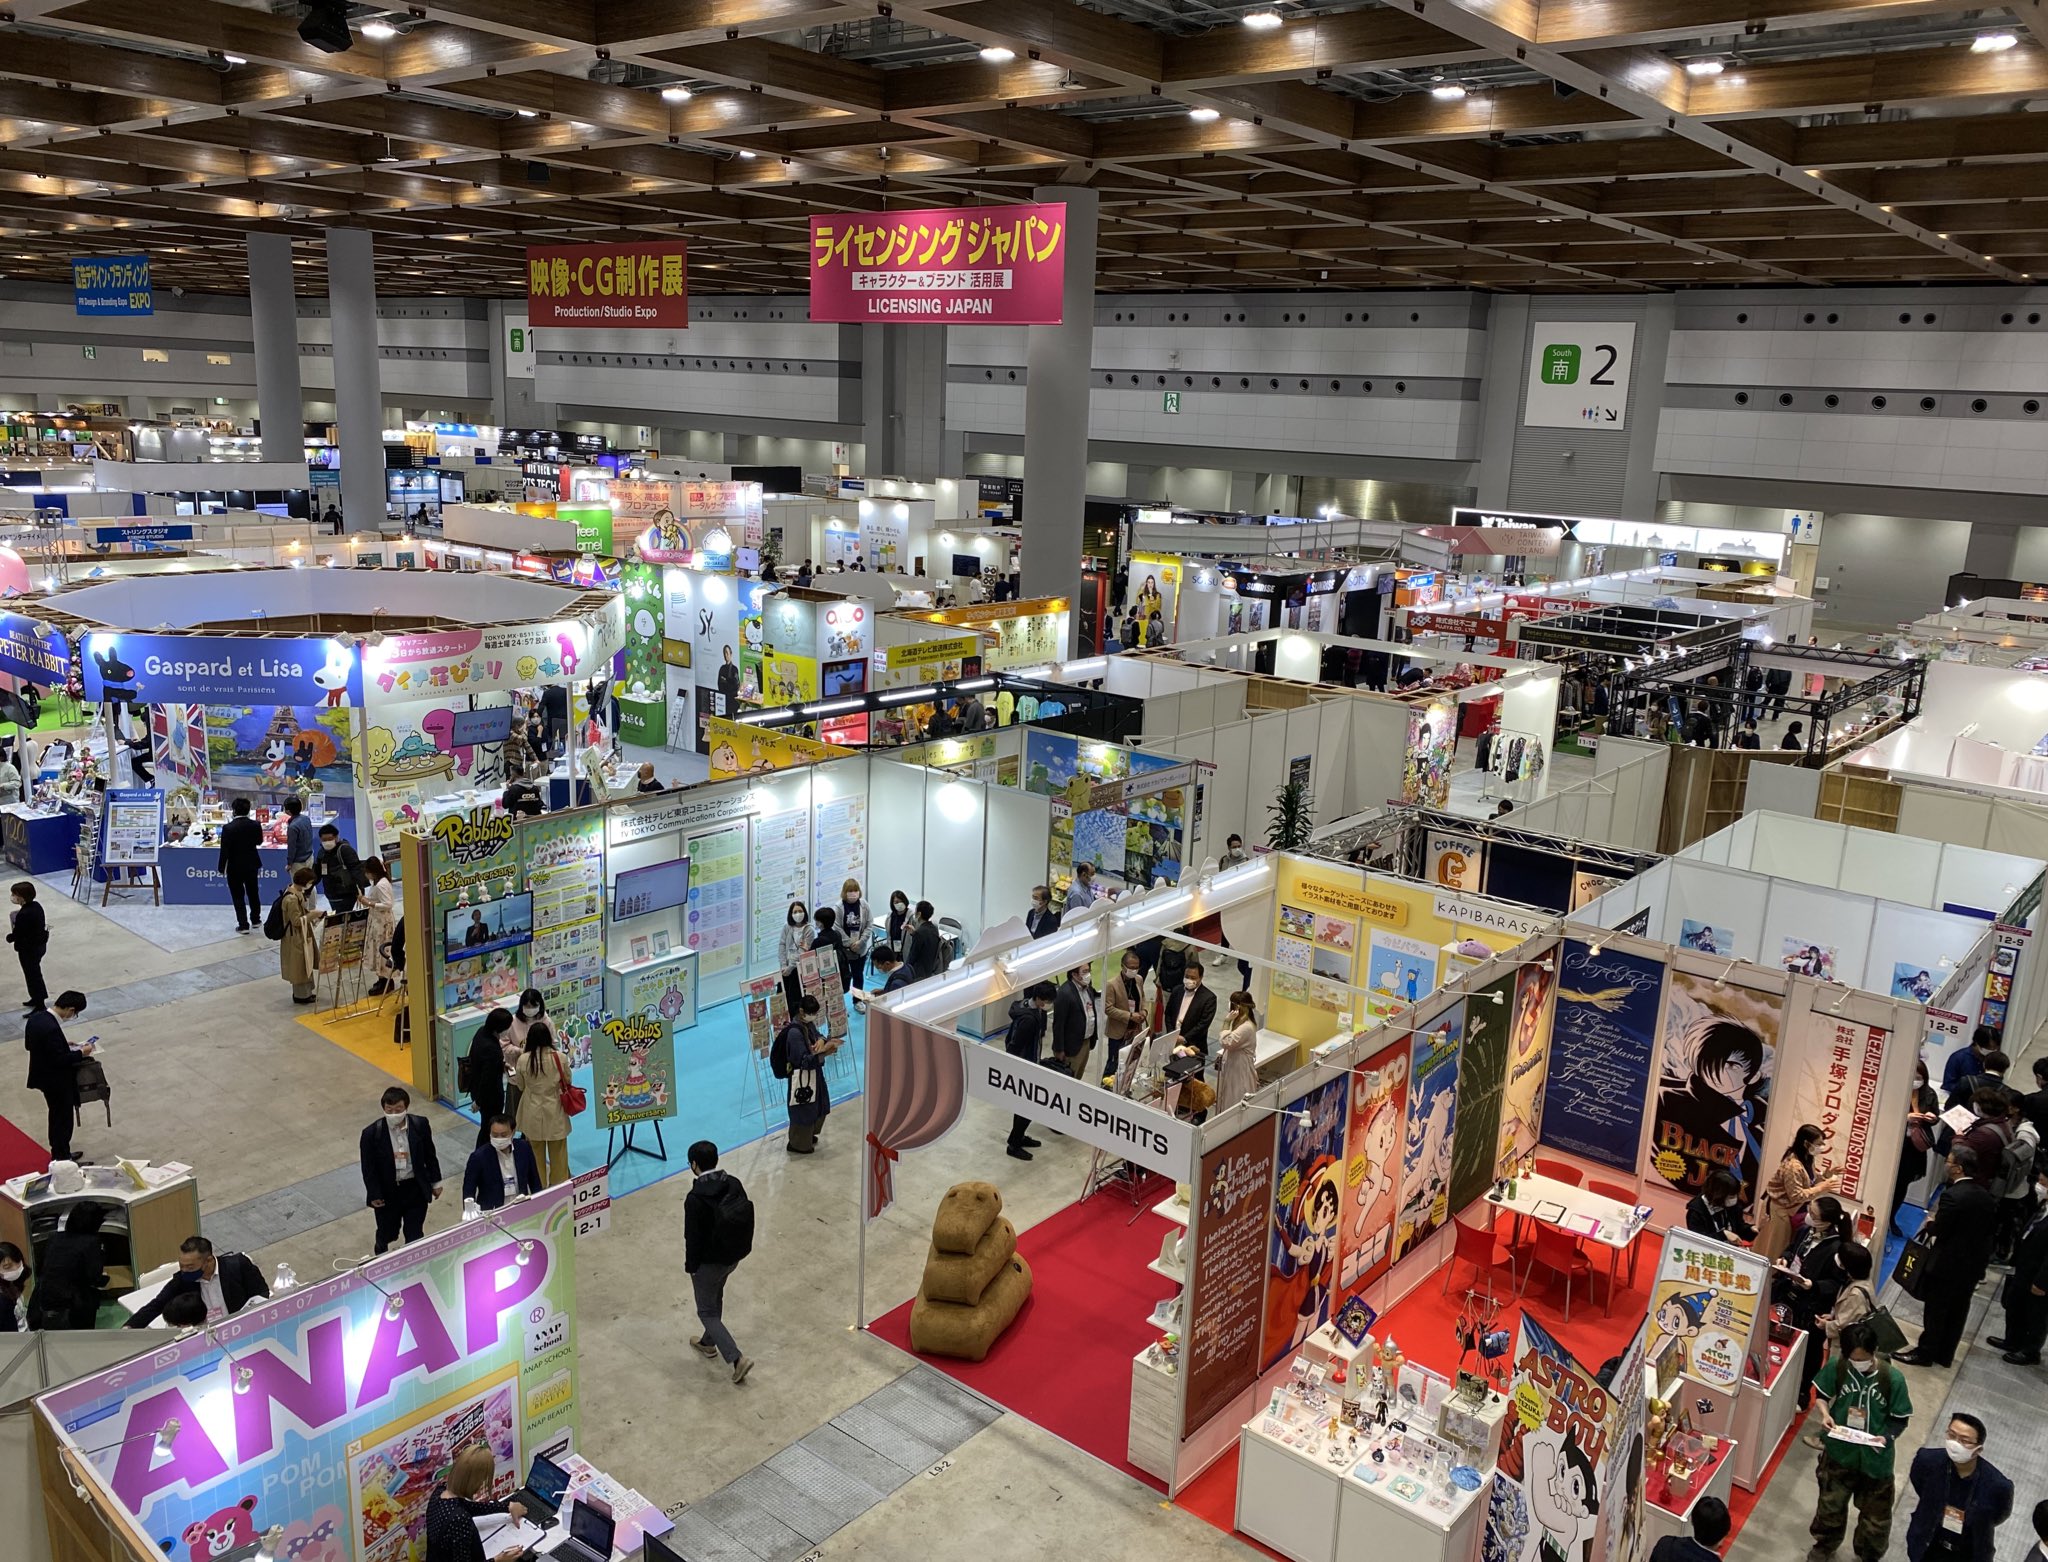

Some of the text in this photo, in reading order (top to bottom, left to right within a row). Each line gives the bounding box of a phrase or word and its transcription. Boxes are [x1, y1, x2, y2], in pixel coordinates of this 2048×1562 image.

[129, 292, 150, 308] EXPO
[868, 298, 992, 314] LICENSING JAPAN
[554, 306, 657, 319] Production/Studio Expo
[1552, 349, 1572, 357] South
[1552, 359, 1569, 380] 南
[1590, 344, 1618, 386] 2
[577, 527, 598, 536] reen
[1519, 531, 1548, 539] TAIWAN
[577, 538, 602, 550] amel
[1517, 539, 1552, 547] CONTENT
[1703, 562, 1730, 572] Power
[1247, 581, 1275, 594] SUNRISE
[1311, 579, 1335, 593] SUNRISE
[512, 638, 534, 647] 24:57
[145, 655, 303, 682] Gaspard et Lisa
[177, 685, 276, 695] sont de vrais Parisiens
[630, 824, 656, 836] TOKYO
[658, 812, 716, 830] Communications
[1434, 839, 1475, 858] COFFEE
[457, 865, 516, 888] Anniversary
[1437, 901, 1543, 934] KAPIBARASA
[1999, 935, 2024, 946] 12-9
[1930, 1019, 1958, 1035] 12-5
[1863, 1033, 1886, 1076] TEZUKA
[622, 1107, 667, 1122] Anniversary
[988, 1066, 1168, 1155] BANDAI SPIRITS
[1816, 1045, 1851, 1174] 手塚プロダクショ
[1660, 1119, 1740, 1169] BLACK
[1227, 1152, 1251, 1182] Let
[1224, 1174, 1266, 1214] Dream
[1842, 1173, 1860, 1196] LTD
[574, 1185, 600, 1205] 10-2
[1341, 1222, 1392, 1291] ユニコ
[1673, 1247, 1735, 1273] 3年連続
[1685, 1264, 1752, 1292] 周年事業
[328, 1281, 351, 1297] PM
[534, 1321, 562, 1341] ANAP
[533, 1333, 563, 1354] School
[523, 1346, 572, 1376] ANAP SCHOOL
[1701, 1352, 1732, 1370] DEBUT
[1705, 1348, 1731, 1361] ATOM
[111, 1237, 550, 1519] ANAP
[1518, 1346, 1608, 1423] ASTRO
[533, 1378, 568, 1405] ANAP
[534, 1389, 566, 1410] BEAUTY
[1519, 1390, 1538, 1408] Osamu
[526, 1403, 574, 1433] ANAP BEAUTY
[1518, 1399, 1541, 1419] TEZUKA
[1547, 1394, 1610, 1471] BOY
[263, 1451, 321, 1496] POM
[929, 1459, 952, 1478] L9-2
